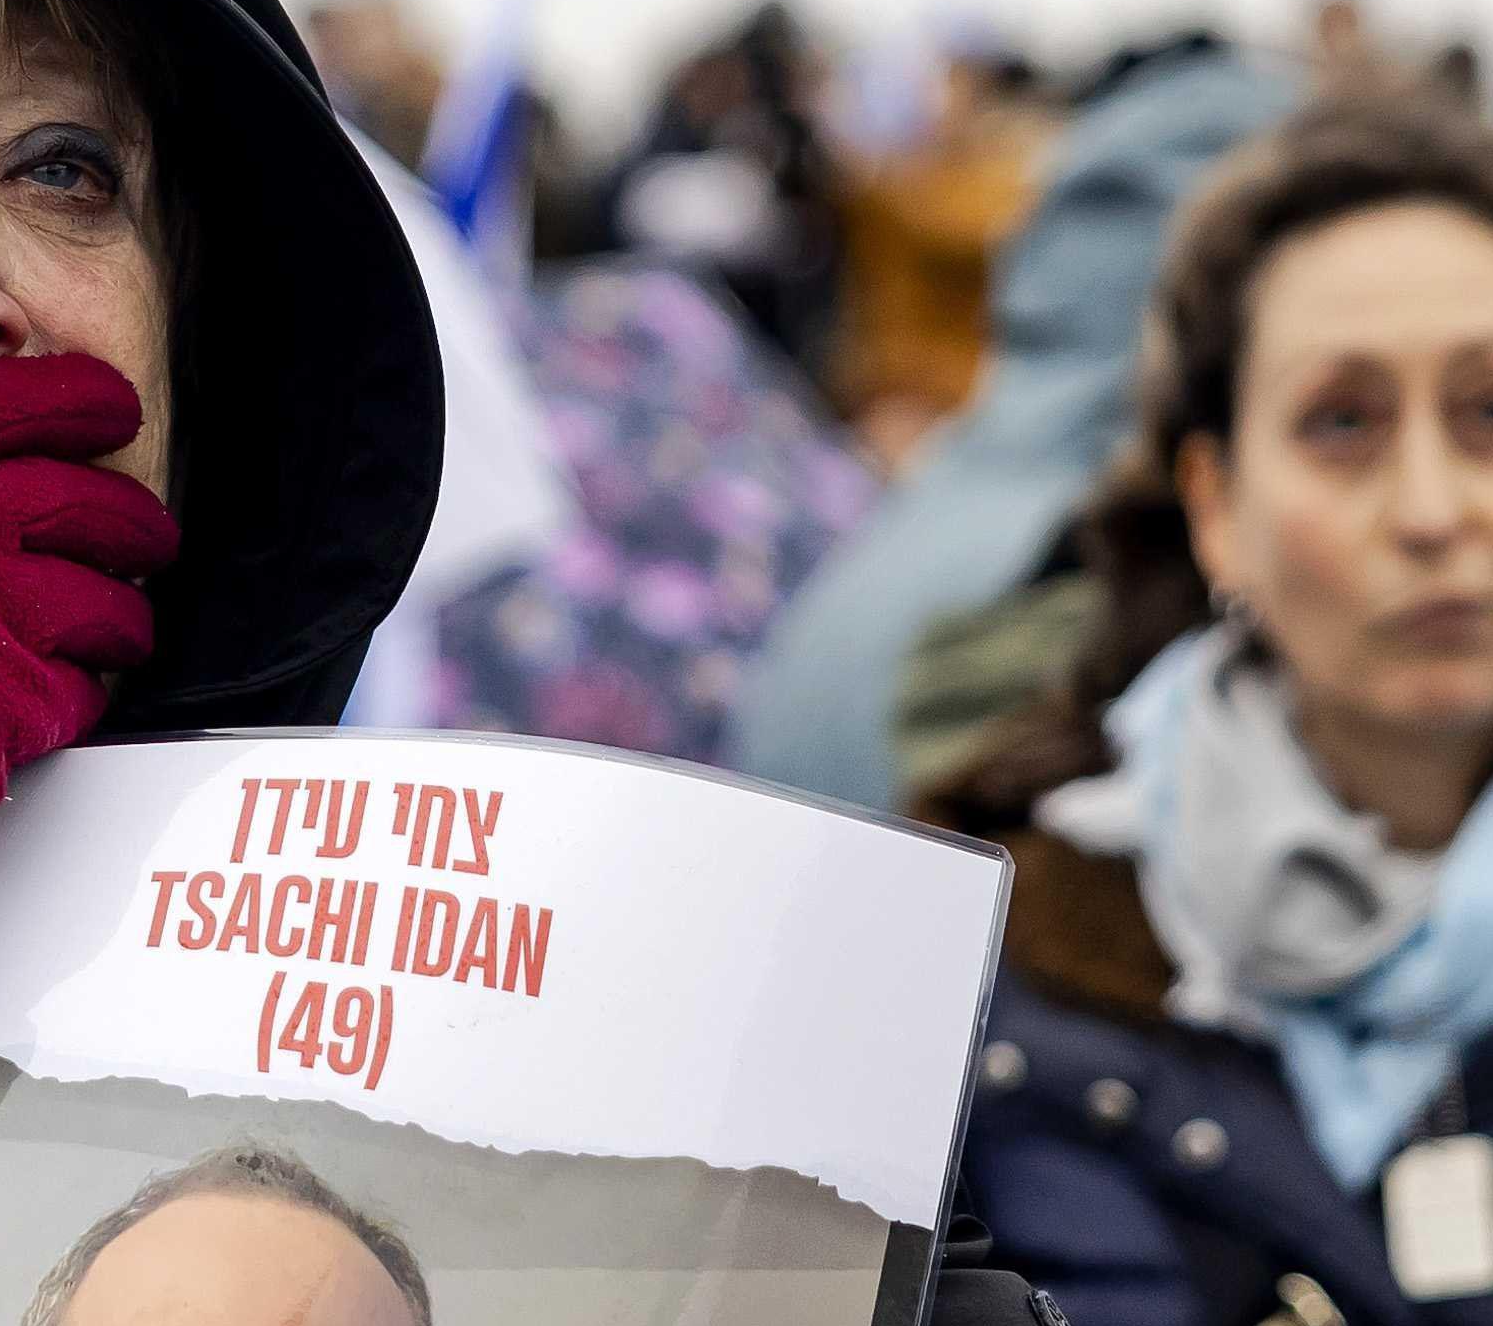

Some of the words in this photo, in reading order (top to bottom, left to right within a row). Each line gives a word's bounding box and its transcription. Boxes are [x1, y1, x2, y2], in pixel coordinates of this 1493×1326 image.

[229, 777, 370, 864] עידן
[392, 782, 504, 876] צחי
[146, 870, 379, 967] TSACHI
[391, 886, 553, 999] IDAN
[256, 971, 394, 1091] (49)
